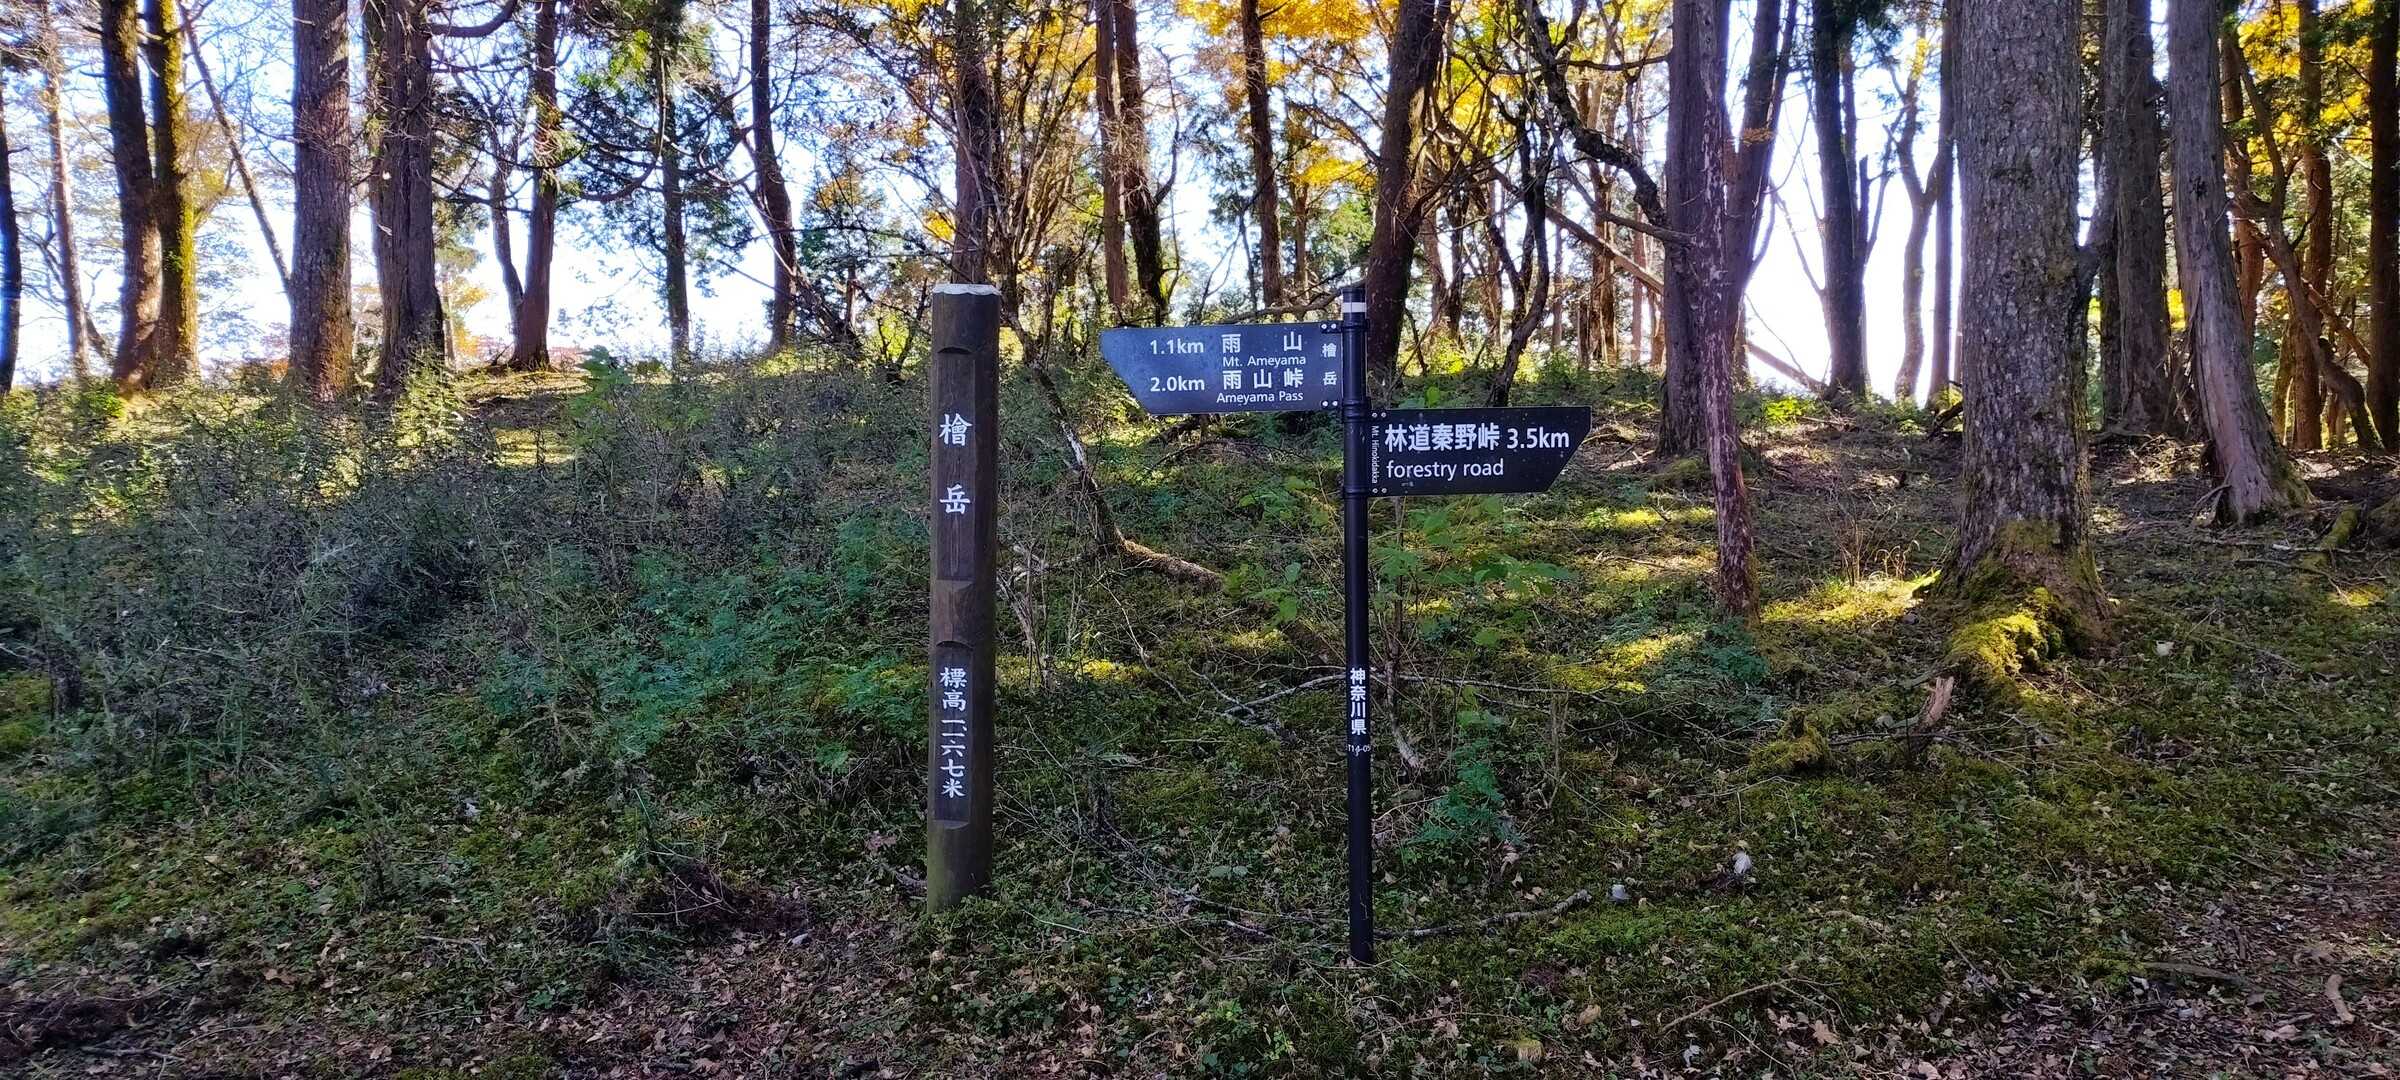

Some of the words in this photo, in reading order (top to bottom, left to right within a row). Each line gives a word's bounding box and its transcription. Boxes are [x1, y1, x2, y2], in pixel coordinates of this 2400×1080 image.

[1150, 338, 1204, 355] 1.1km
[1222, 356, 1243, 368] Mt.
[1247, 356, 1306, 370] Ameyama
[1150, 376, 1205, 392] 2.0km
[1222, 369, 1304, 390] 雨山峠
[1216, 392, 1275, 405] Ameyama
[1278, 391, 1304, 402] Pass
[1371, 425, 1380, 439] Mt.
[1384, 422, 1501, 453] 林道秦野峠
[1506, 426, 1570, 450] 3.5km
[1386, 459, 1457, 481] forestry
[1462, 458, 1504, 477] road
[1350, 667, 1367, 736] 神奈川県
